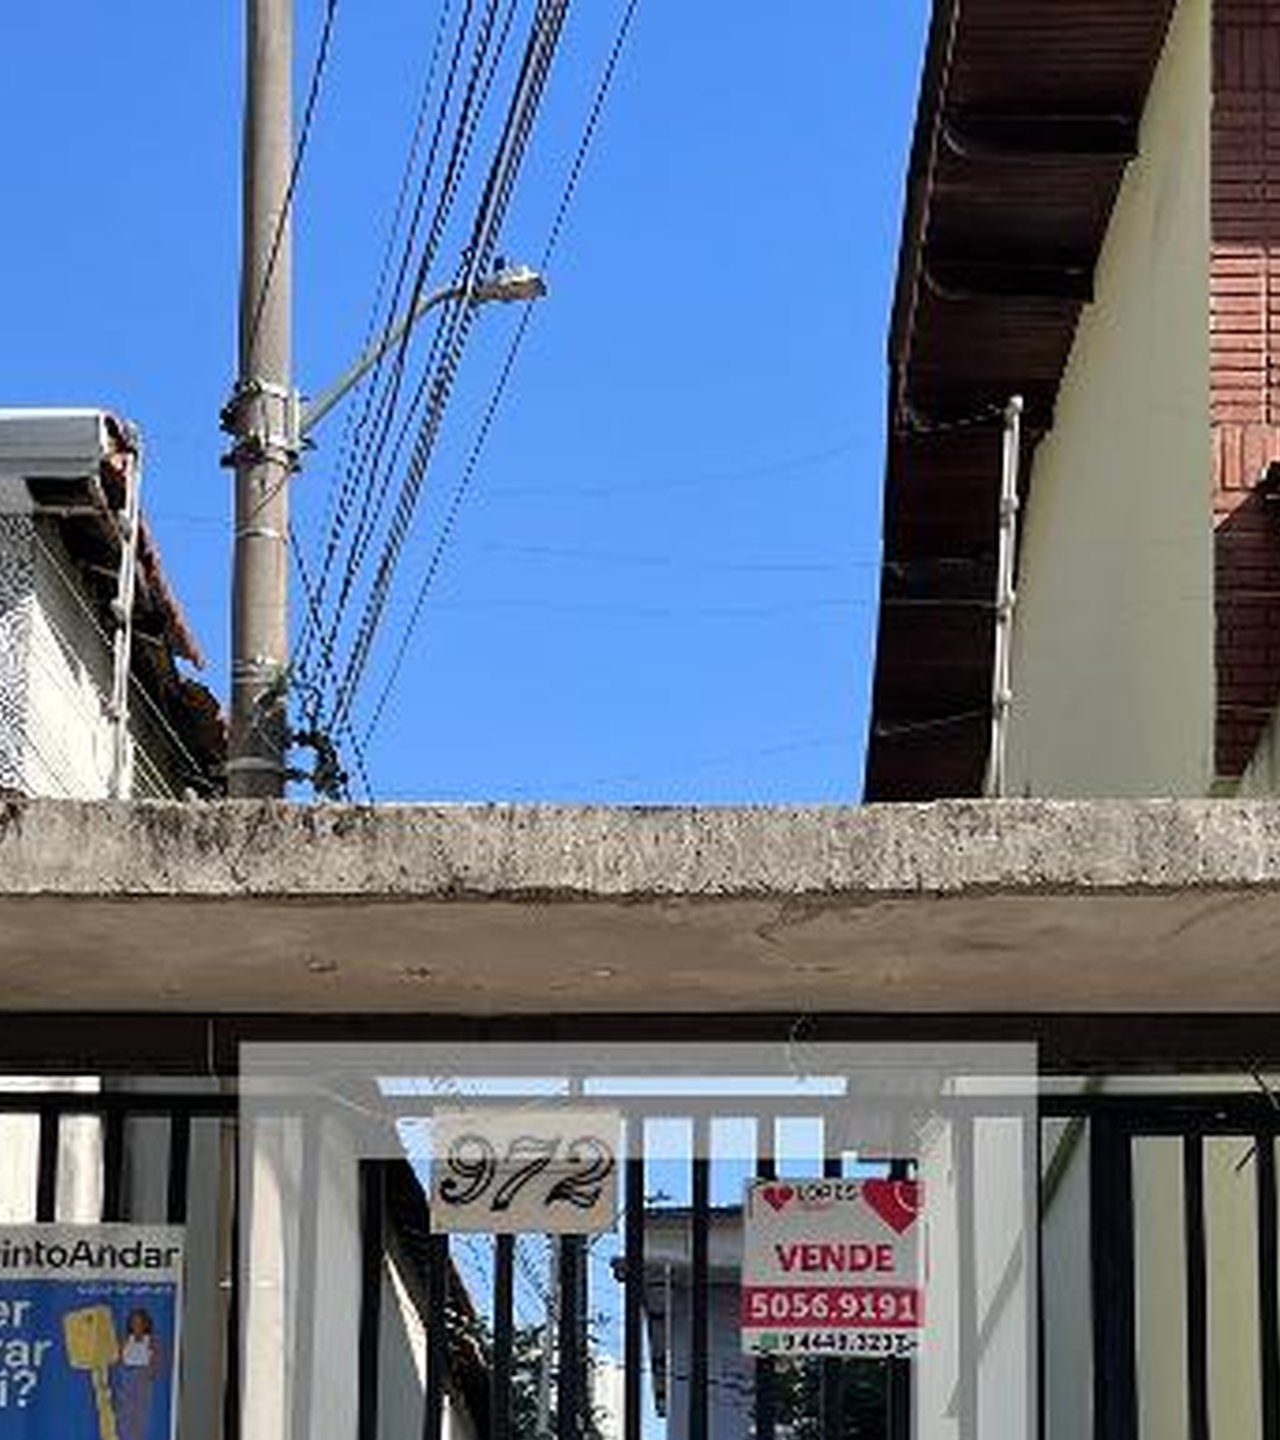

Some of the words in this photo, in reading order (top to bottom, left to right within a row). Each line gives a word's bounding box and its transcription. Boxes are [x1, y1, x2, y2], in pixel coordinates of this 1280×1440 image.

[439, 1134, 616, 1212] 972
[775, 1244, 895, 1273] VENDE
[751, 1293, 916, 1320] 5056.9191
